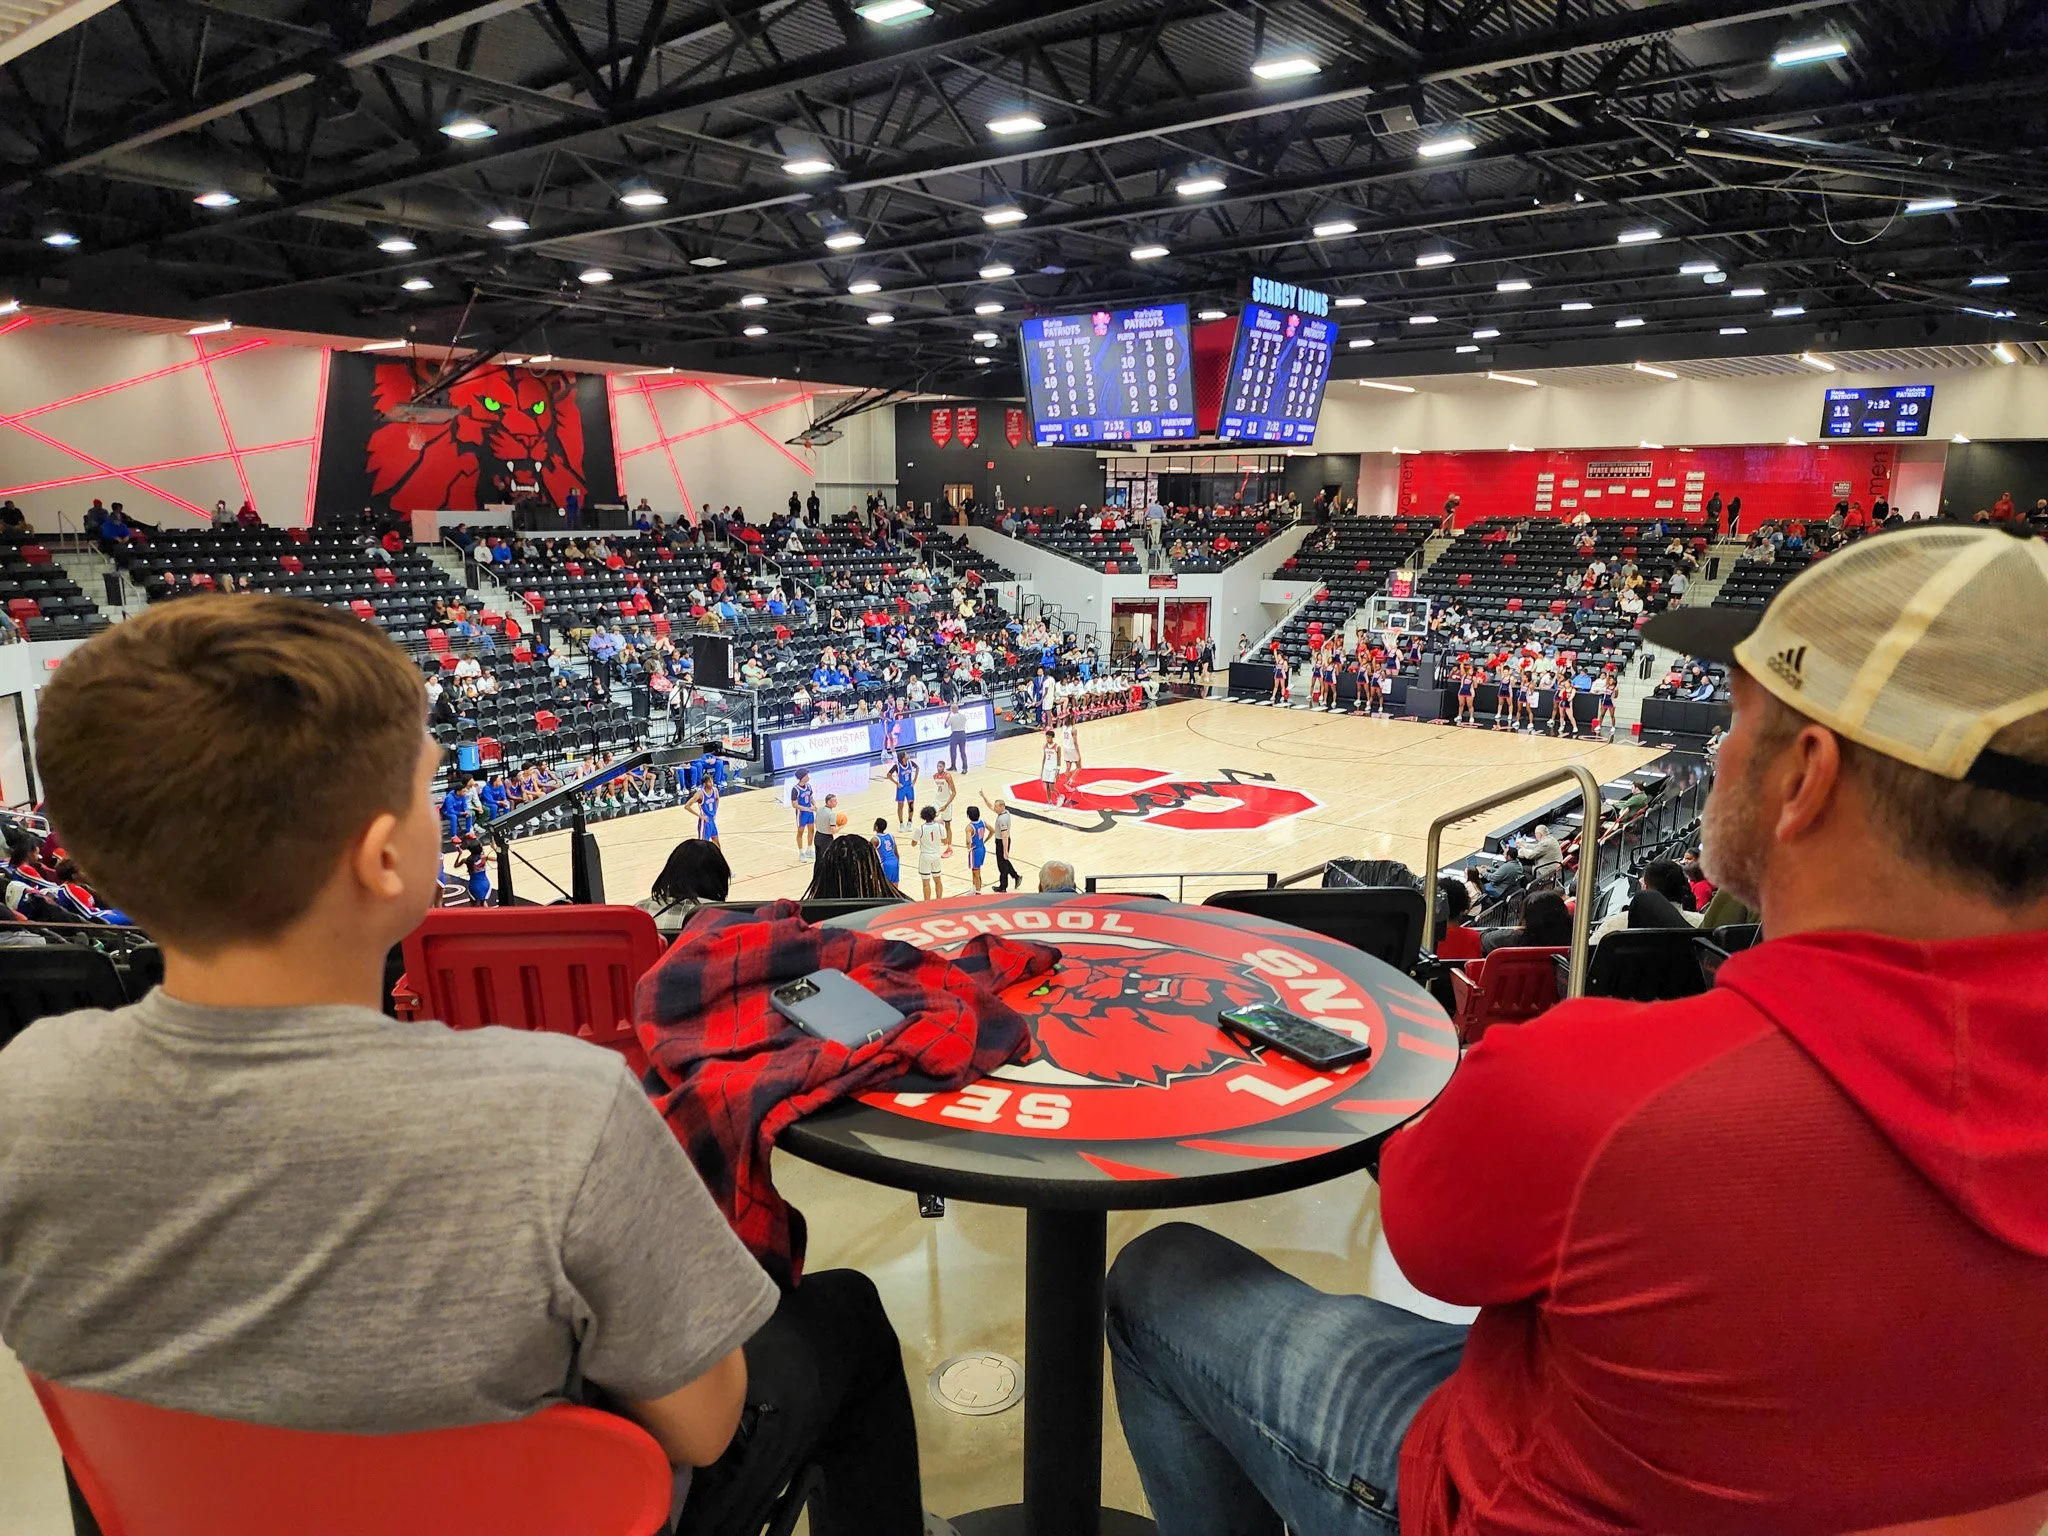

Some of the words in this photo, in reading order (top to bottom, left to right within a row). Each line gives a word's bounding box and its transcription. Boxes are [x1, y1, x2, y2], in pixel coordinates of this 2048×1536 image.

[1252, 276, 1297, 309] SEARCY
[1298, 287, 1328, 317] LIONS
[1124, 317, 1164, 330] PATRIOTS
[1044, 325, 1080, 338] PATRIOTS
[1126, 341, 1133, 353] 5
[1145, 340, 1153, 352] 1
[1165, 337, 1173, 350] 0
[1047, 348, 1055, 360] 2
[1065, 347, 1072, 358] 1
[1083, 345, 1090, 356] 2
[1049, 362, 1056, 374] 1
[1066, 360, 1074, 373] 0
[1085, 359, 1092, 371] 1
[1121, 356, 1135, 369] 10
[1146, 355, 1154, 367] 0
[1166, 353, 1174, 365] 0
[1044, 376, 1057, 389] 10
[1068, 375, 1075, 387] 0
[1086, 374, 1093, 385] 2
[1123, 372, 1136, 384] 11
[1147, 370, 1155, 382] 0
[1168, 368, 1175, 381] 5
[1051, 391, 1058, 402] 4
[1069, 389, 1076, 401] 0
[1088, 388, 1094, 400] 3
[1130, 386, 1138, 398] 0
[1149, 385, 1157, 397] 0
[1168, 383, 1177, 396] 0
[1048, 405, 1060, 417] 13
[1071, 404, 1078, 416] 1
[1089, 403, 1096, 415] 3
[1131, 401, 1139, 413] 2
[1150, 400, 1158, 412] 2
[1169, 398, 1178, 411] 0
[1834, 405, 1849, 417] 11
[1867, 400, 1890, 409] 7:32
[1900, 403, 1918, 415] 10
[1104, 421, 1124, 431] 7:32
[1137, 421, 1152, 433] 10
[1161, 418, 1192, 427] PARKVIEW
[1074, 424, 1089, 436] 11
[1869, 451, 1888, 496] men
[1767, 656, 1803, 690] adidas
[831, 746, 848, 756] EMS
[929, 831, 934, 842] 1
[880, 910, 1135, 949] SCHOOL
